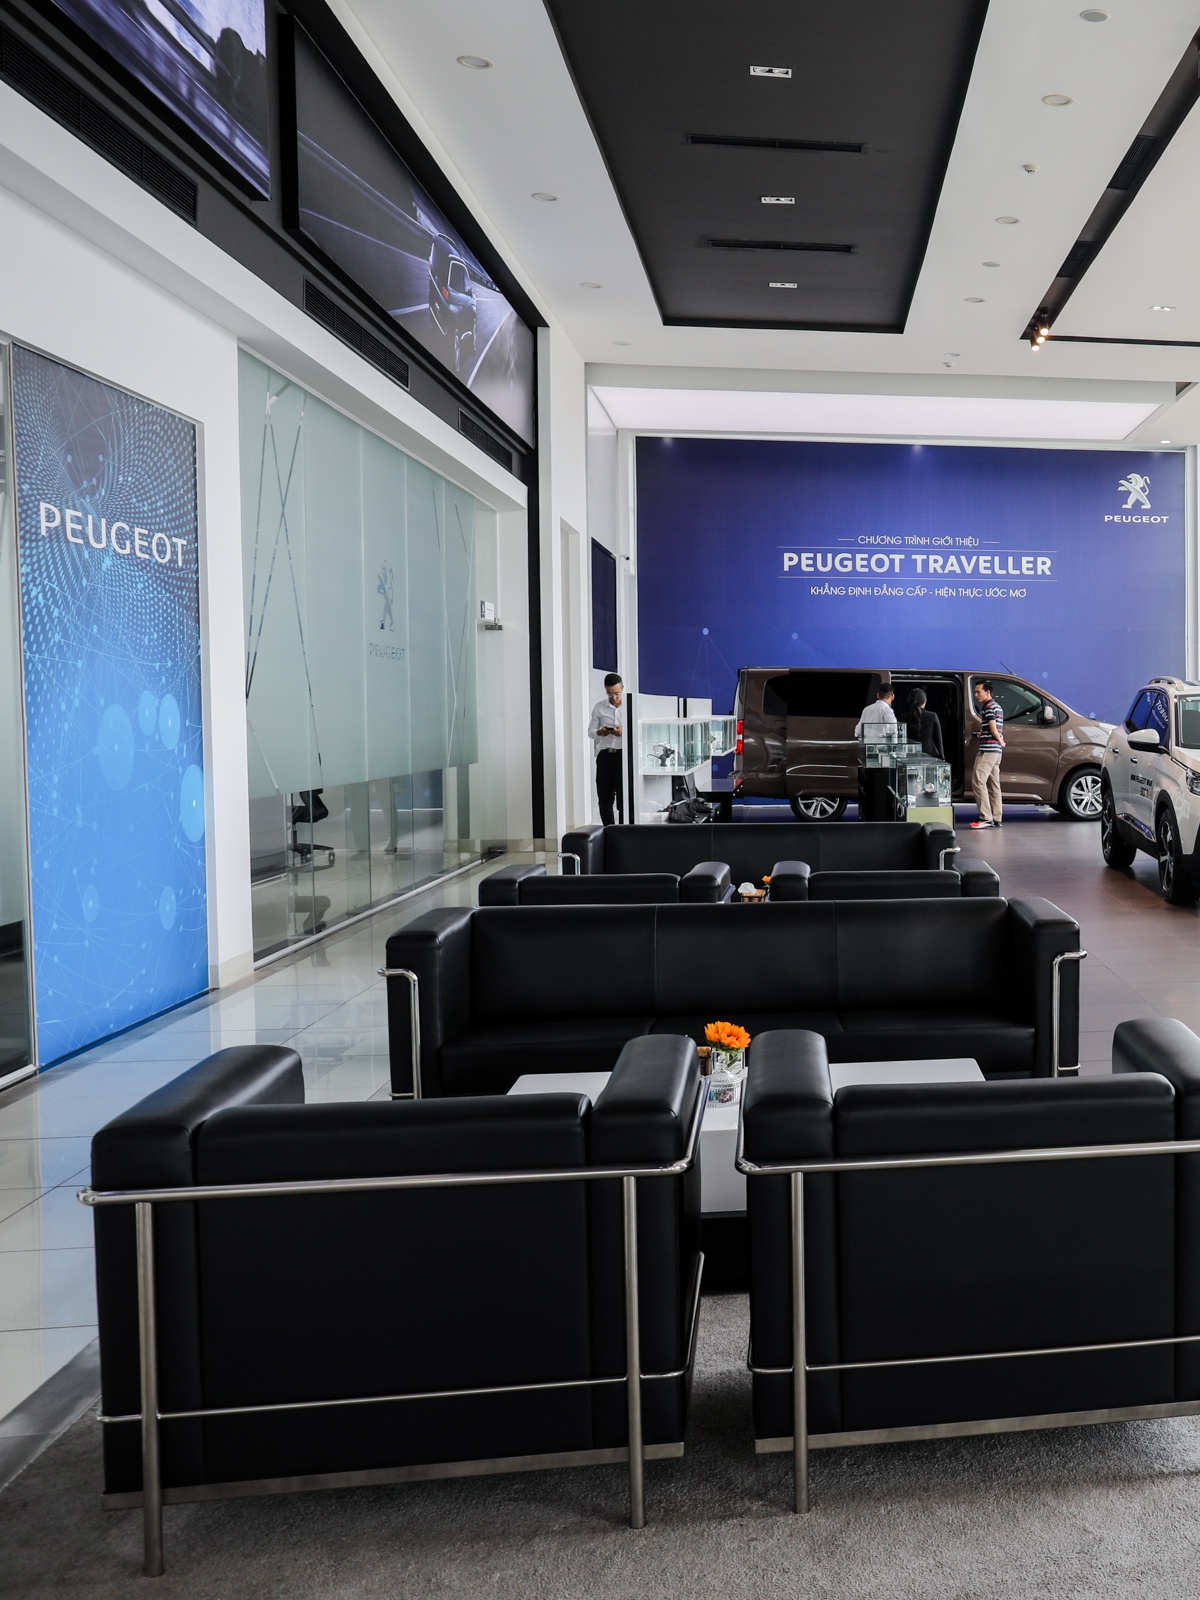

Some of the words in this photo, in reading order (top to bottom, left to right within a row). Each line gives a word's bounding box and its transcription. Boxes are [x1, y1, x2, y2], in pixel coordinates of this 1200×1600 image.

[1104, 515, 1169, 523] PEUGEOT
[39, 501, 187, 567] PEUGEOT
[858, 535, 902, 545] CHƯƠNG
[904, 535, 931, 546] TRÌNH
[932, 535, 953, 546] GIỚI
[955, 537, 979, 548] THIỆU
[783, 552, 905, 573] PEUGEOT
[911, 554, 1051, 575] TRAVELLER
[810, 582, 846, 596] KHẲNG
[848, 586, 872, 598] ĐỊNH
[873, 583, 904, 596] ĐẲNG
[906, 584, 927, 597] CẤP
[935, 585, 956, 598] HIỆN
[958, 587, 983, 599] THỰC
[984, 585, 1008, 598] ƯỚC
[1009, 587, 1027, 598] MƠ
[368, 642, 406, 661] PEUGEOT
